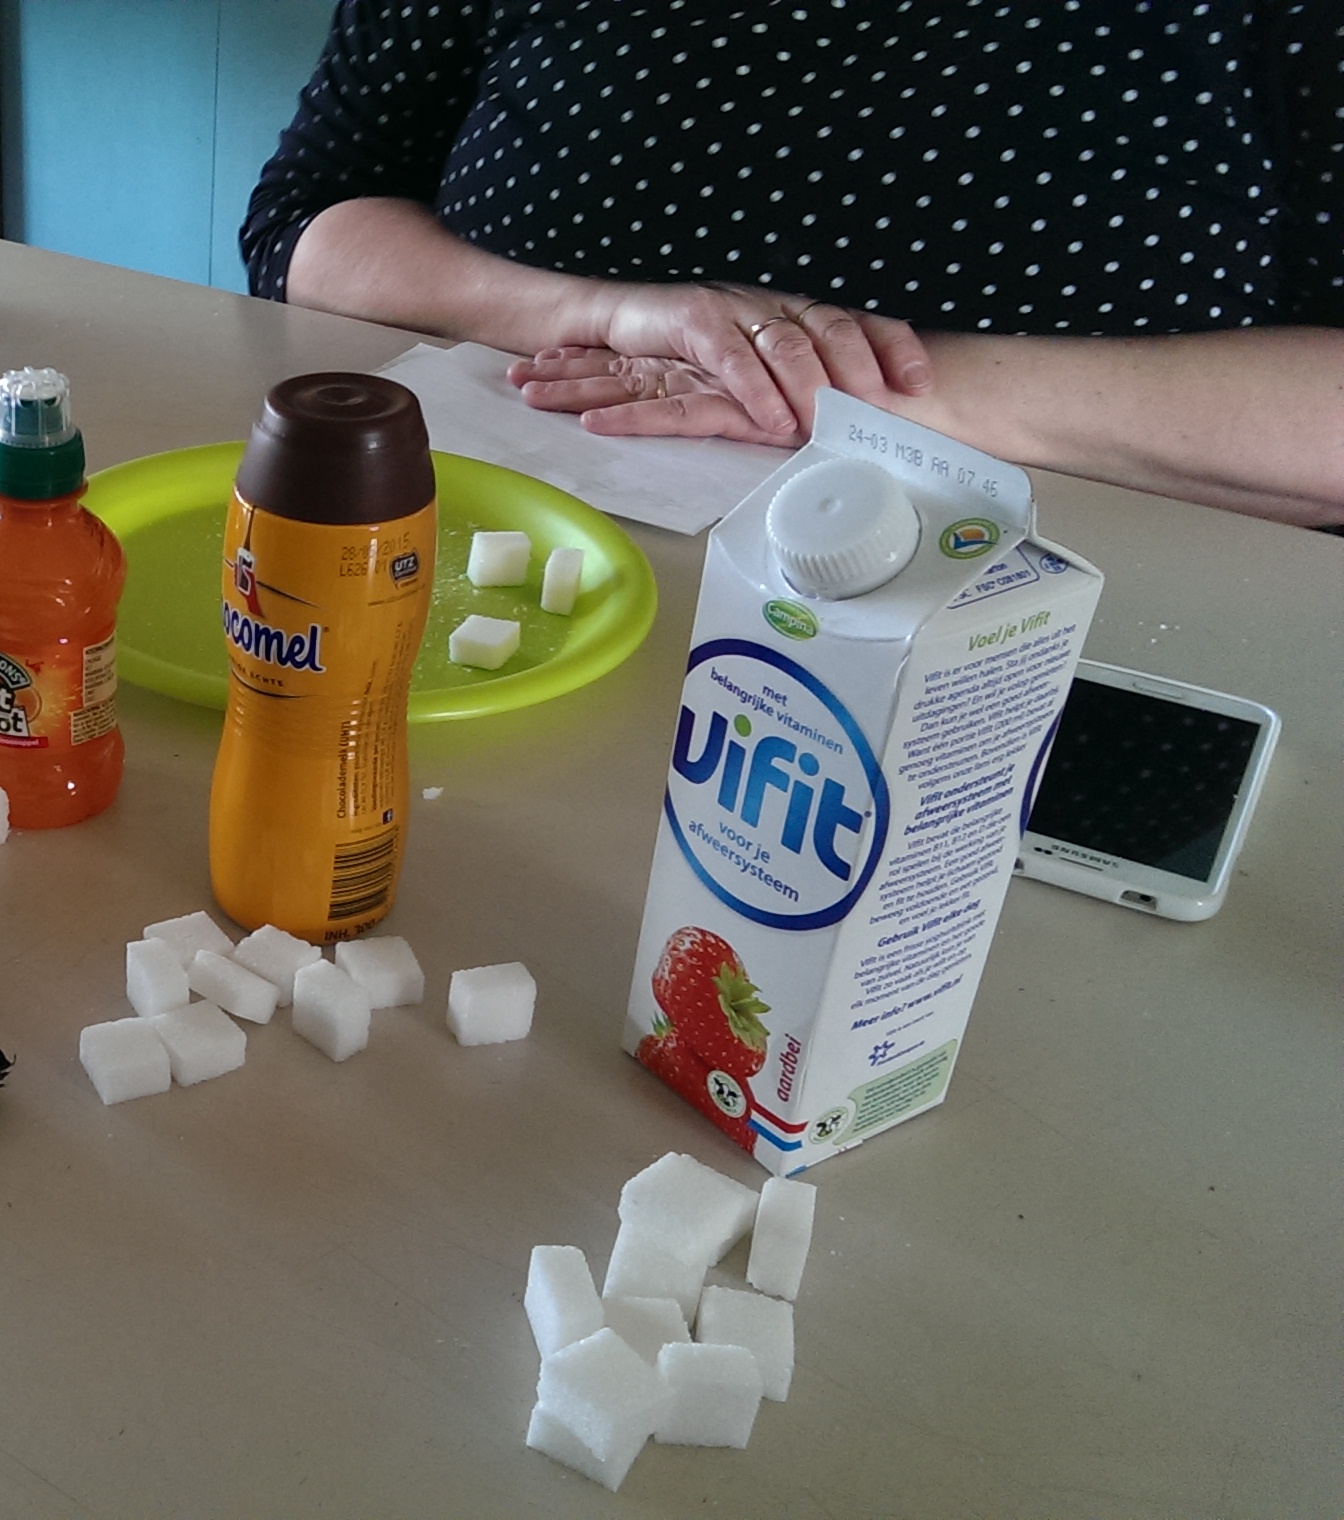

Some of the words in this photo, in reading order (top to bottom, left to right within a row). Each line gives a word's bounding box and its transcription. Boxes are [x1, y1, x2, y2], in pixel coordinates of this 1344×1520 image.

[848, 424, 888, 454] 24-03
[394, 555, 417, 572] UTZ
[222, 602, 325, 672] ocomel
[767, 602, 814, 636] Campina
[969, 626, 1002, 651] Voel
[1021, 611, 1050, 633] Vifit
[710, 667, 774, 717] belangrijke
[776, 710, 844, 755] vitaminen
[762, 685, 789, 707] met
[337, 750, 349, 820] Chocolademelk
[920, 792, 943, 806] Vifit
[944, 768, 1005, 798] ondersteunt
[688, 820, 800, 902] afweersysteem
[719, 822, 753, 851] voor
[754, 843, 771, 864] je
[1051, 844, 1120, 869] SAMSUNG
[878, 926, 919, 947] Gebruik
[922, 917, 942, 931] Vifit
[943, 909, 962, 922] elke
[963, 900, 980, 913] dag
[776, 1033, 802, 1103] aardbei
